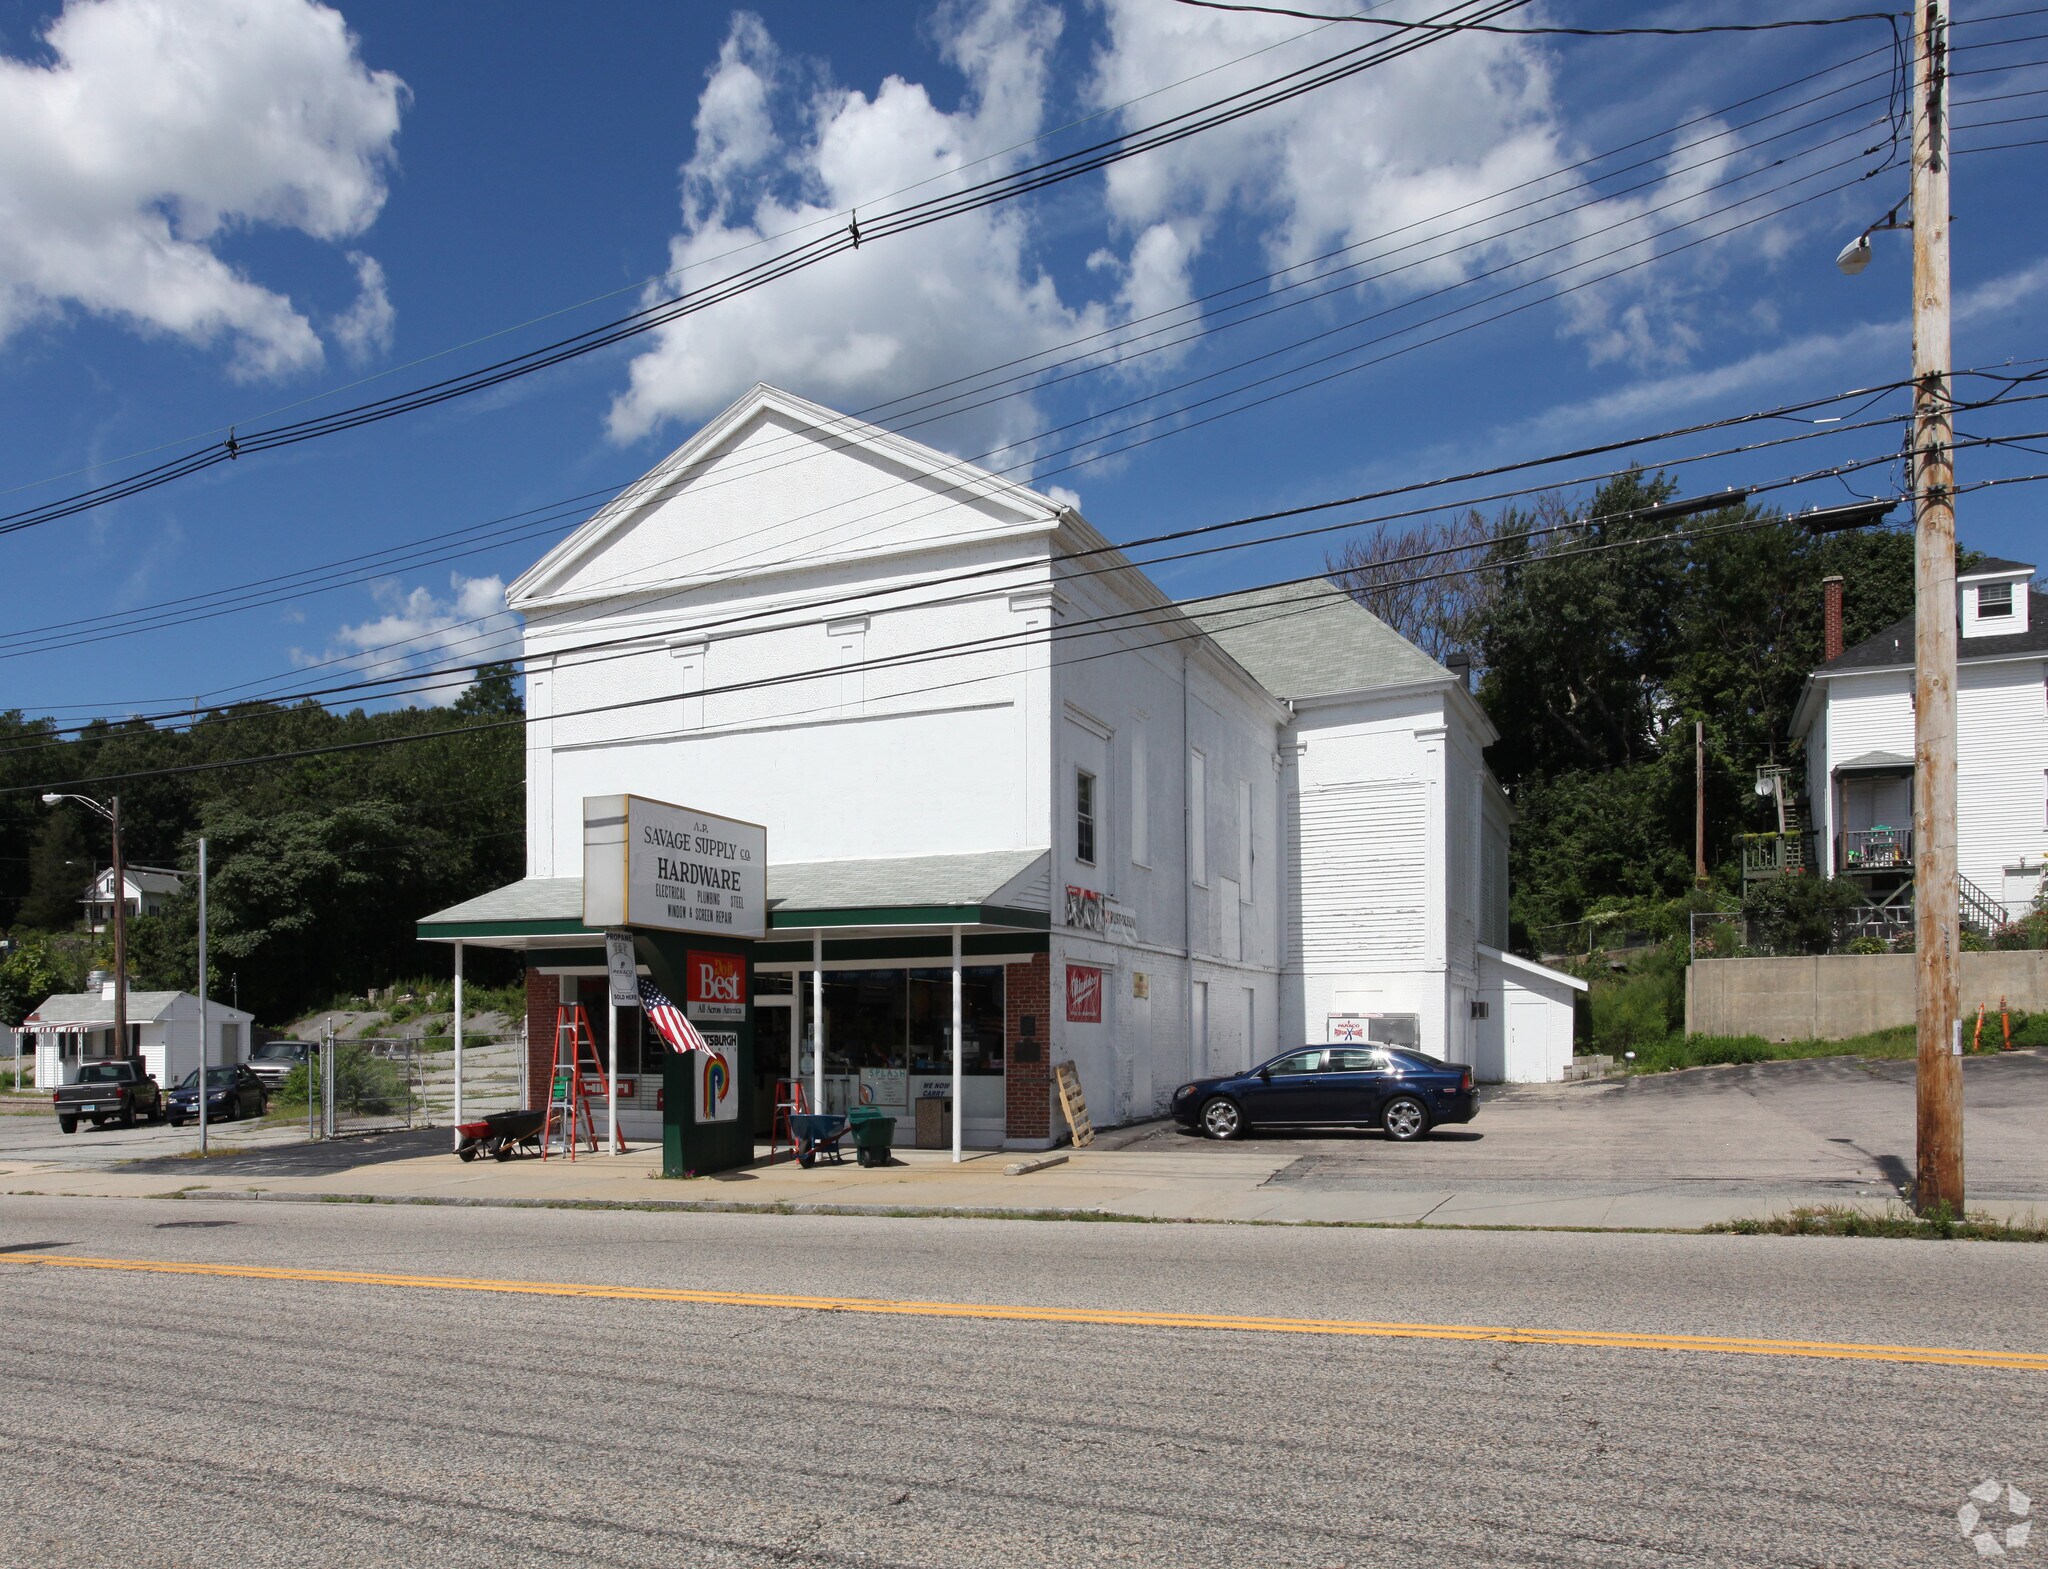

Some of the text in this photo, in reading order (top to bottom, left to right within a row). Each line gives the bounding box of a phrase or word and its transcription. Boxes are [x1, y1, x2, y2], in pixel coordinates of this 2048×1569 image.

[644, 825, 691, 852] SAVAGE
[695, 836, 737, 860] SUPPLY
[657, 857, 741, 892] HARDWARE
[655, 883, 744, 909] ELECTRICAL PLUMBING STEEL
[667, 904, 686, 919] WINDOW
[695, 907, 714, 922] SCREEN
[715, 910, 732, 925] REPAIR
[606, 932, 633, 942] PROPANE
[699, 963, 740, 1000] Best
[697, 1003, 706, 1013] All
[700, 1034, 737, 1046] TTSBURGH
[869, 1069, 906, 1078] SPLASH
[584, 1083, 629, 1093] HII
